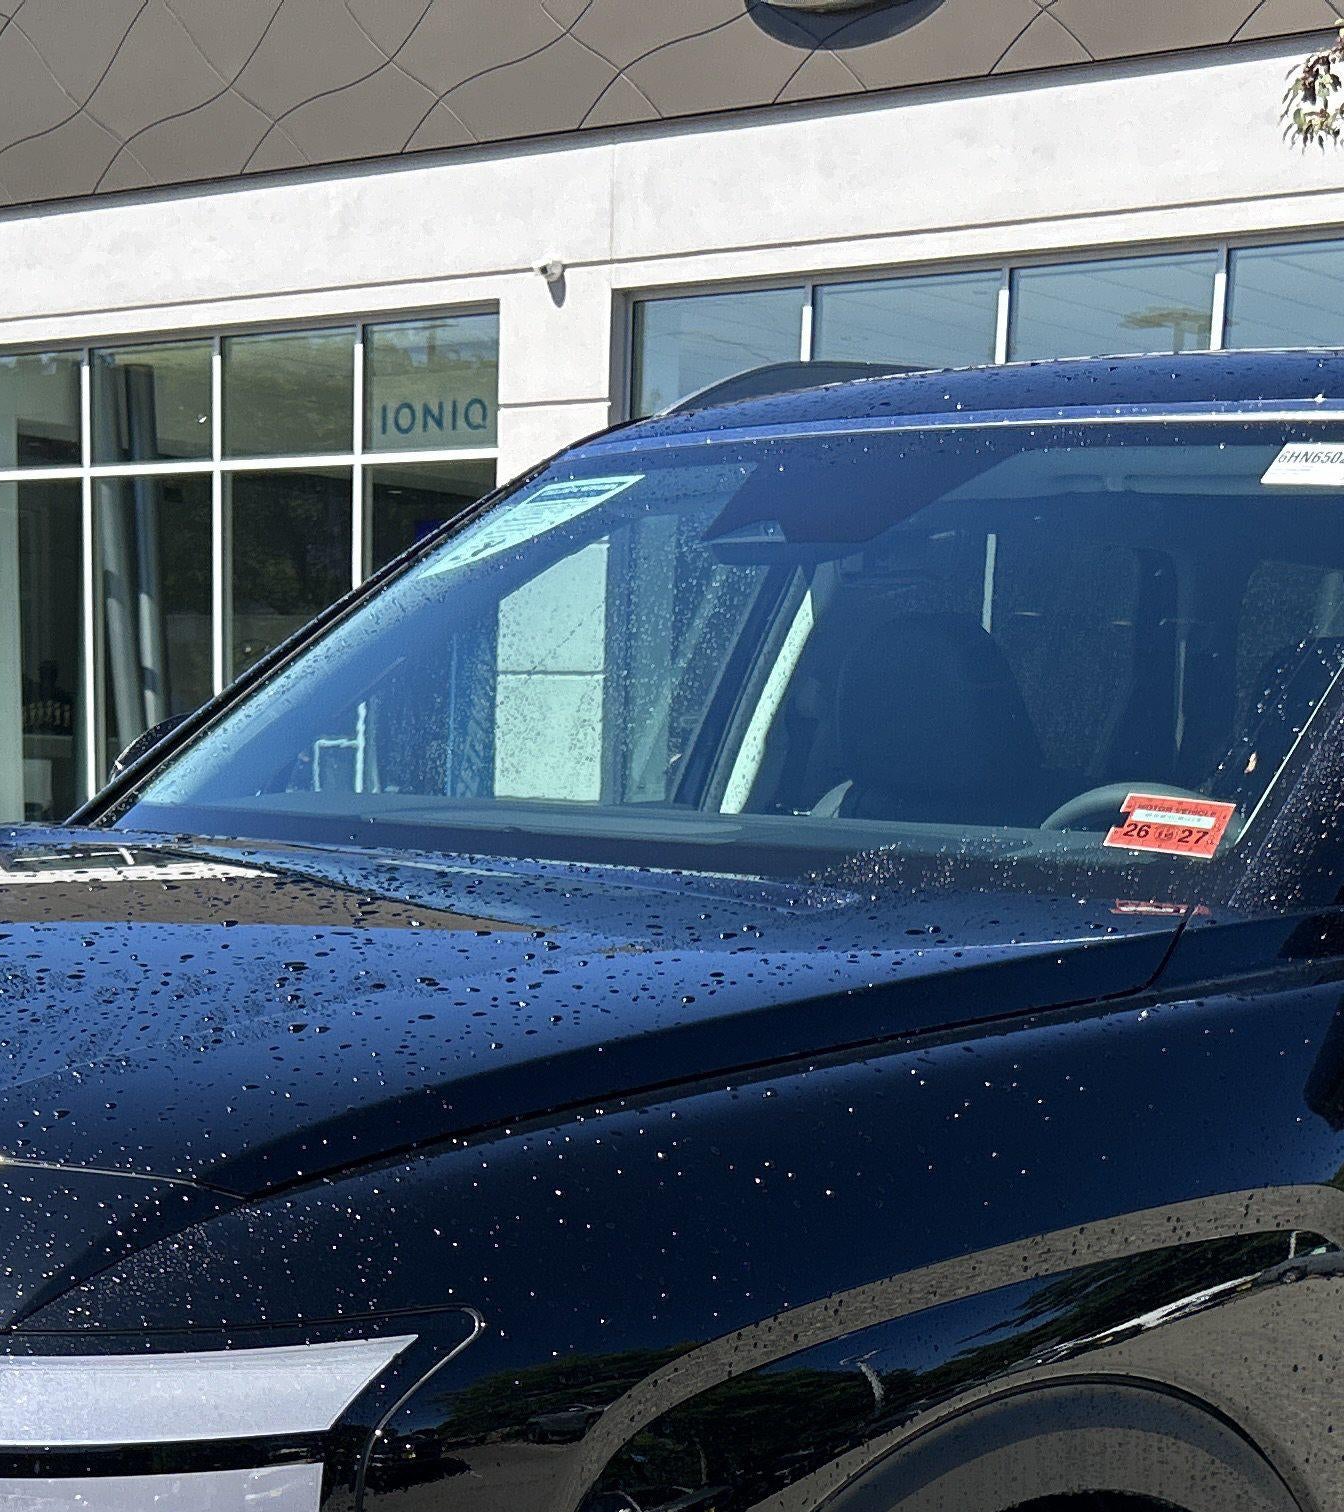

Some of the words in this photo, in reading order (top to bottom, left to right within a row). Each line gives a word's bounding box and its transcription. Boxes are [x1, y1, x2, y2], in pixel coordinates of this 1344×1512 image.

[381, 397, 489, 436] IONIQ
[1122, 822, 1152, 839] 26
[1177, 827, 1209, 845] 27
